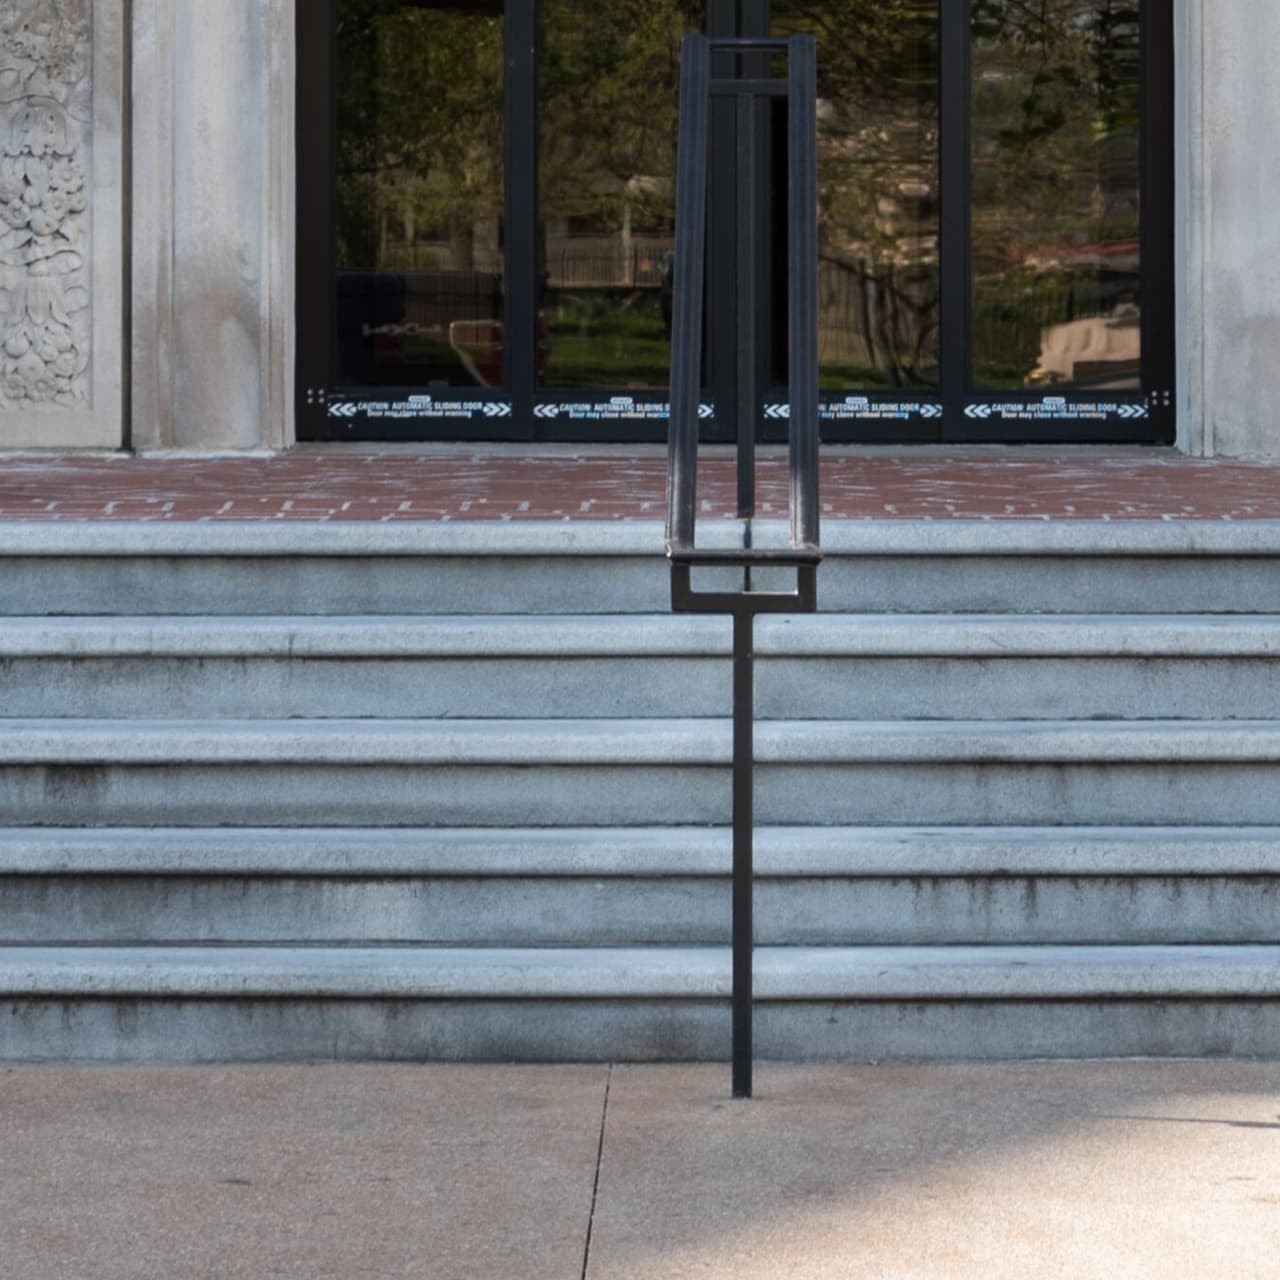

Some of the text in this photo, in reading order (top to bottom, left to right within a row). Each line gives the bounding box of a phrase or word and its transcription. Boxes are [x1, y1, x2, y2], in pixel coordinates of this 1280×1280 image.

[392, 402, 432, 411] AUTOMATIC
[434, 402, 461, 411] SLIDING
[463, 402, 482, 411] DOOR
[594, 404, 634, 412] AUTOMATIC
[636, 404, 663, 412] SLIDING
[829, 404, 869, 412] AUTOMATIC
[871, 404, 898, 412] SLIDING
[900, 404, 919, 412] DOOR
[1026, 404, 1067, 412] AUTOMATIC
[1069, 404, 1096, 412] SLIDING
[1097, 404, 1117, 412] DOOR
